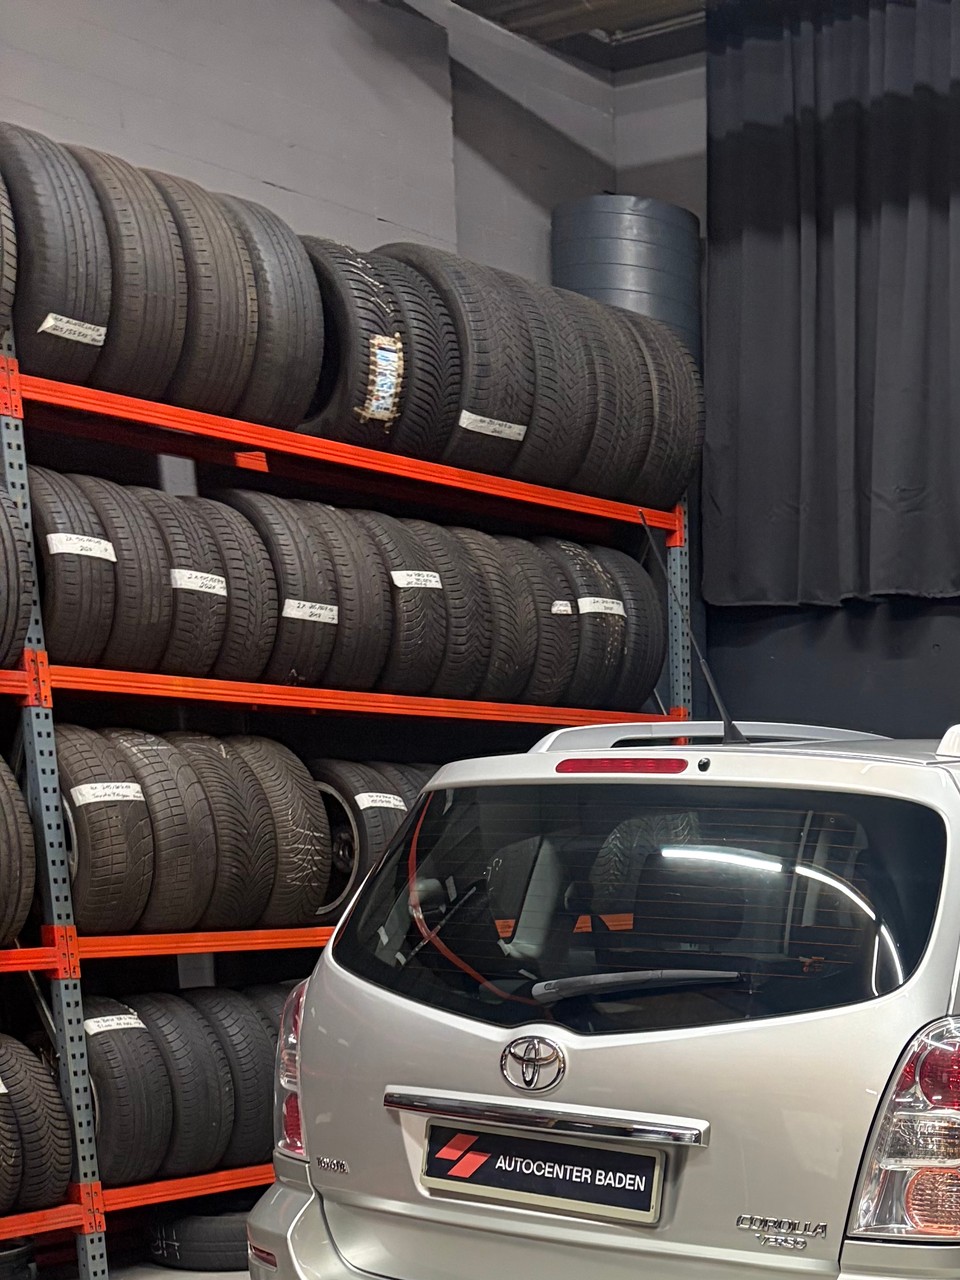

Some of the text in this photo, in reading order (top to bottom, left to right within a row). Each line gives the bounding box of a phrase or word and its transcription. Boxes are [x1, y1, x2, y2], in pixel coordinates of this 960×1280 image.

[495, 1155, 646, 1192] AUTOCENTER BADEN
[736, 1214, 828, 1238] COROLLA
[754, 1233, 807, 1250] VERSO
